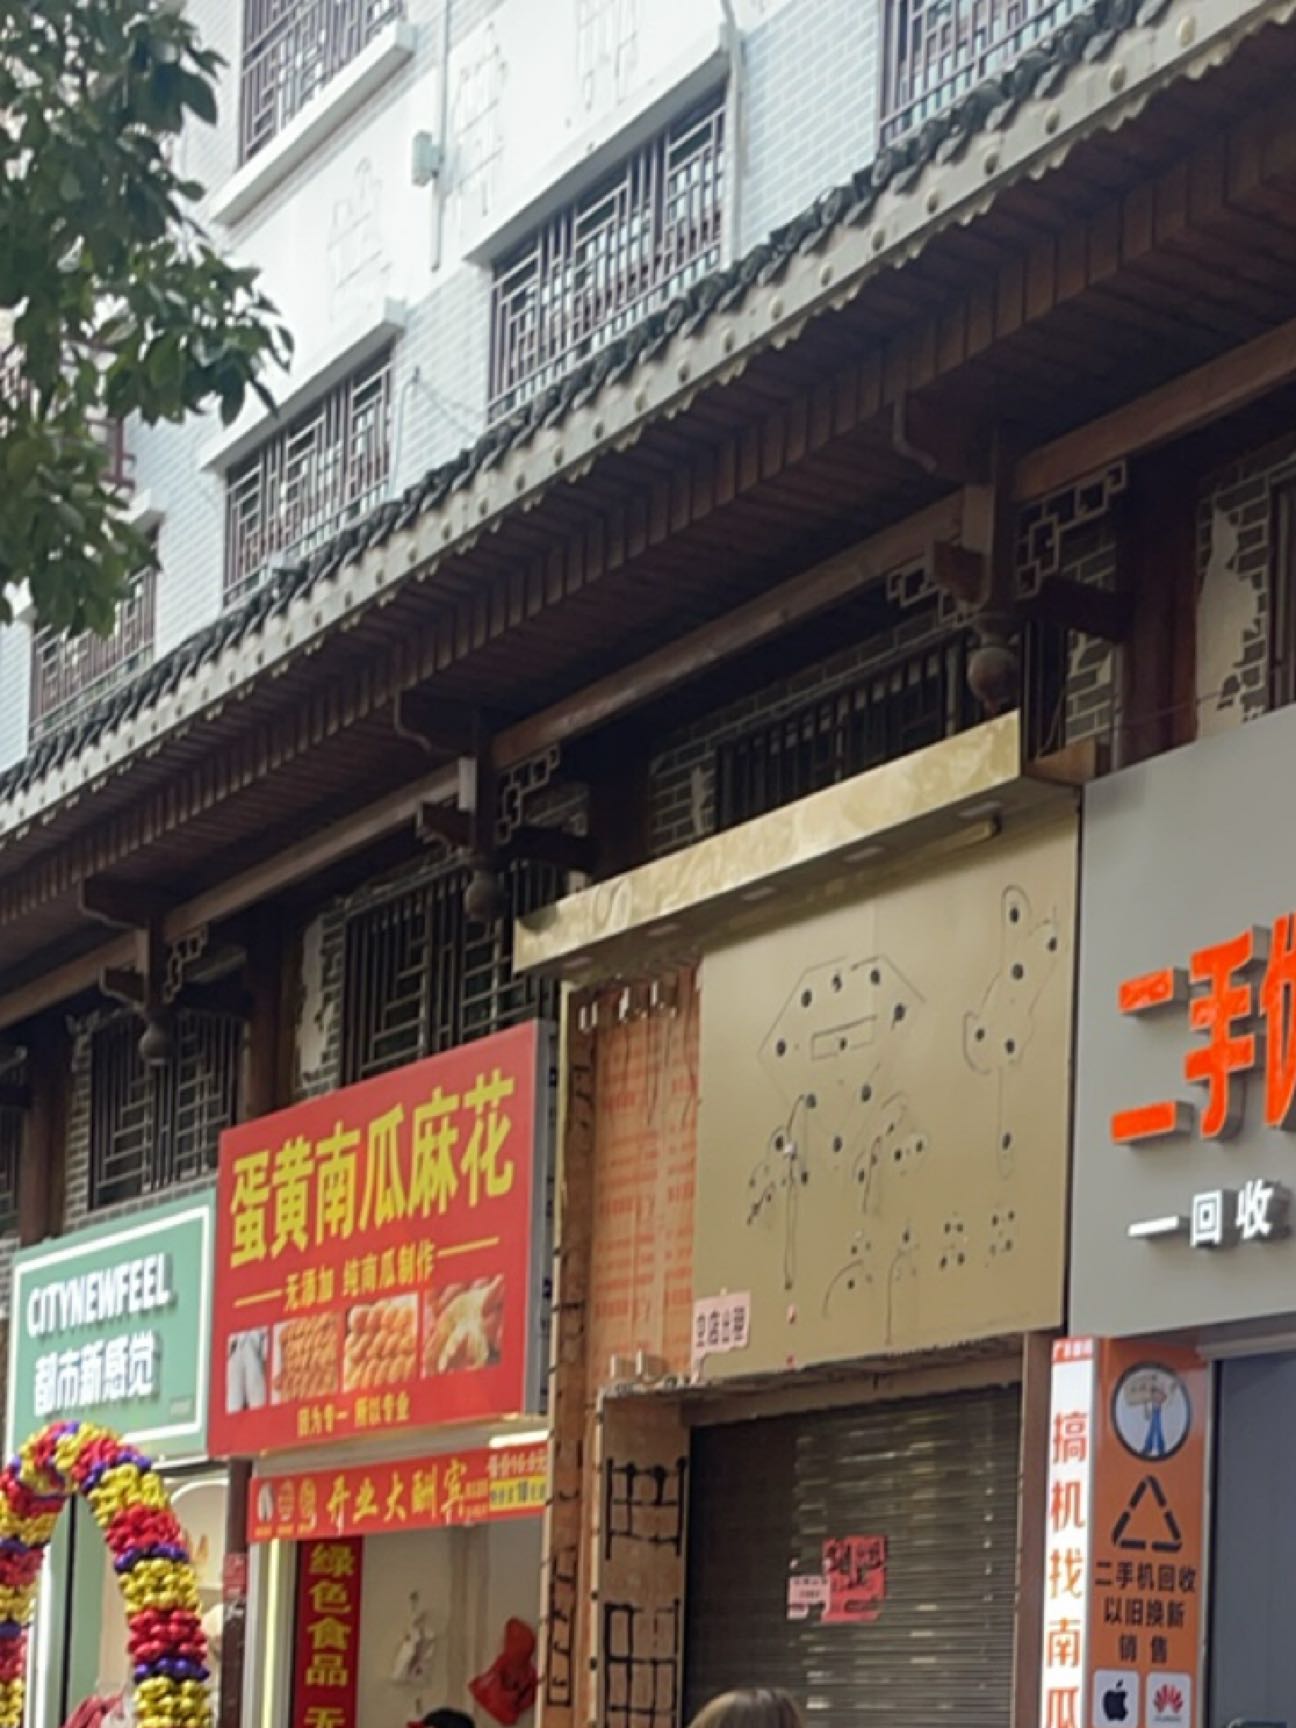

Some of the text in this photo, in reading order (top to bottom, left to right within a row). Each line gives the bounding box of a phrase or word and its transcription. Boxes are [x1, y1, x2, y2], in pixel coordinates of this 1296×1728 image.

[230, 1068, 515, 1268] 蛋黄南瓜麻花
[27, 1253, 172, 1338] CITYNEWFEEL
[35, 1329, 154, 1416] 都市新感觉
[1095, 1561, 1196, 1593] 二手机回收
[1104, 1597, 1185, 1629] 以旧换新
[1118, 1634, 1168, 1665] 销售
